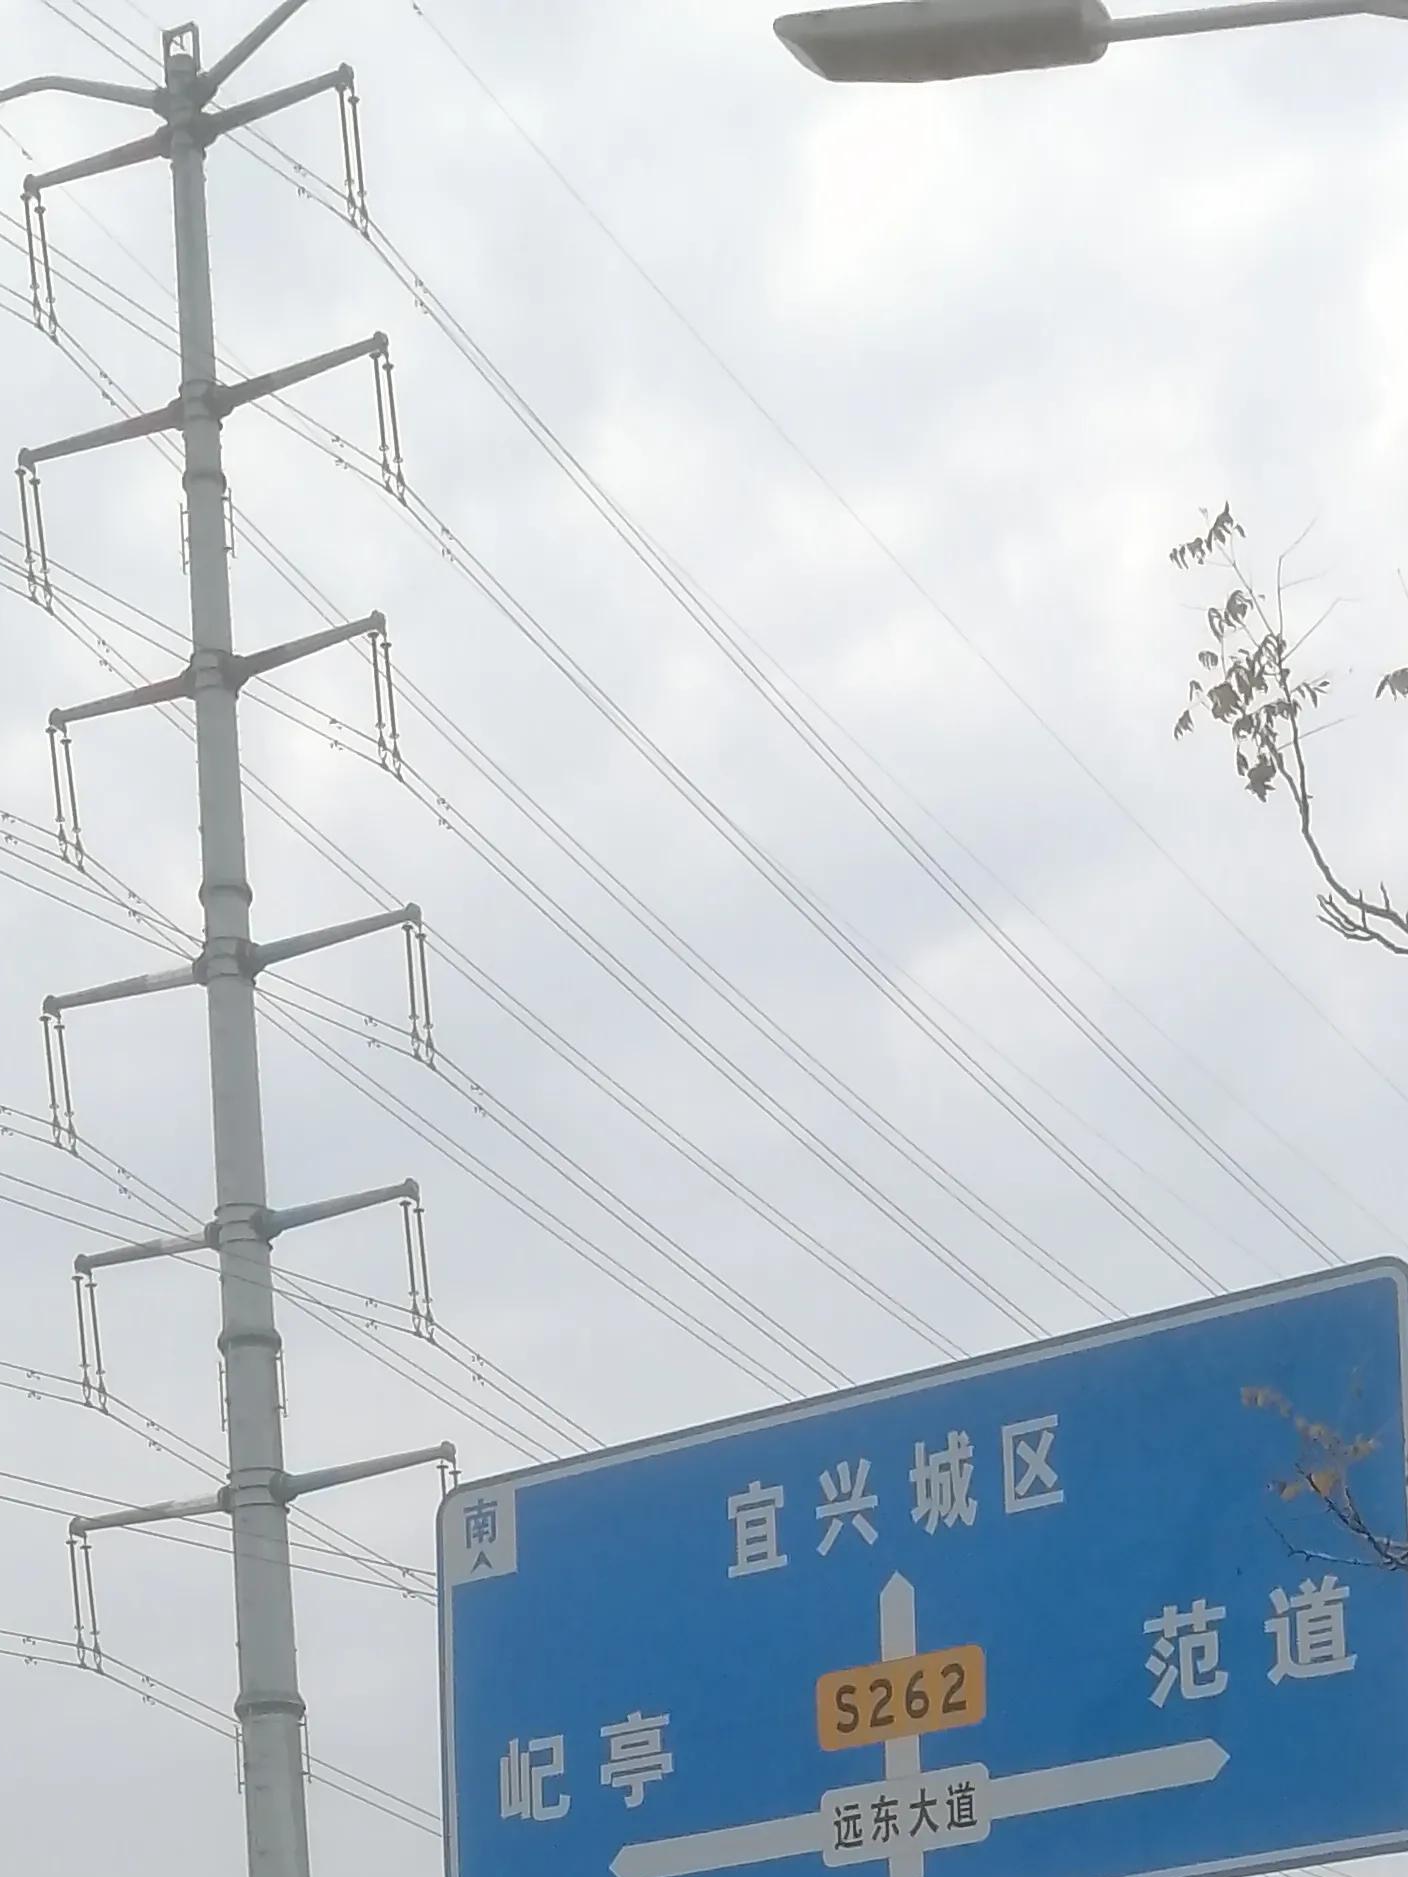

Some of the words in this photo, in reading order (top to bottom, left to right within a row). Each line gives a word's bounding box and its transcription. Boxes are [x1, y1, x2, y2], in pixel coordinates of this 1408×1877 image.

[463, 1498, 498, 1549] 南
[727, 1413, 1065, 1579] 宜兴城区
[1142, 1575, 1359, 1709] 范道
[835, 1662, 968, 1734] S262
[500, 1710, 674, 1821] 屺亭
[833, 1780, 979, 1850] 远东大道
